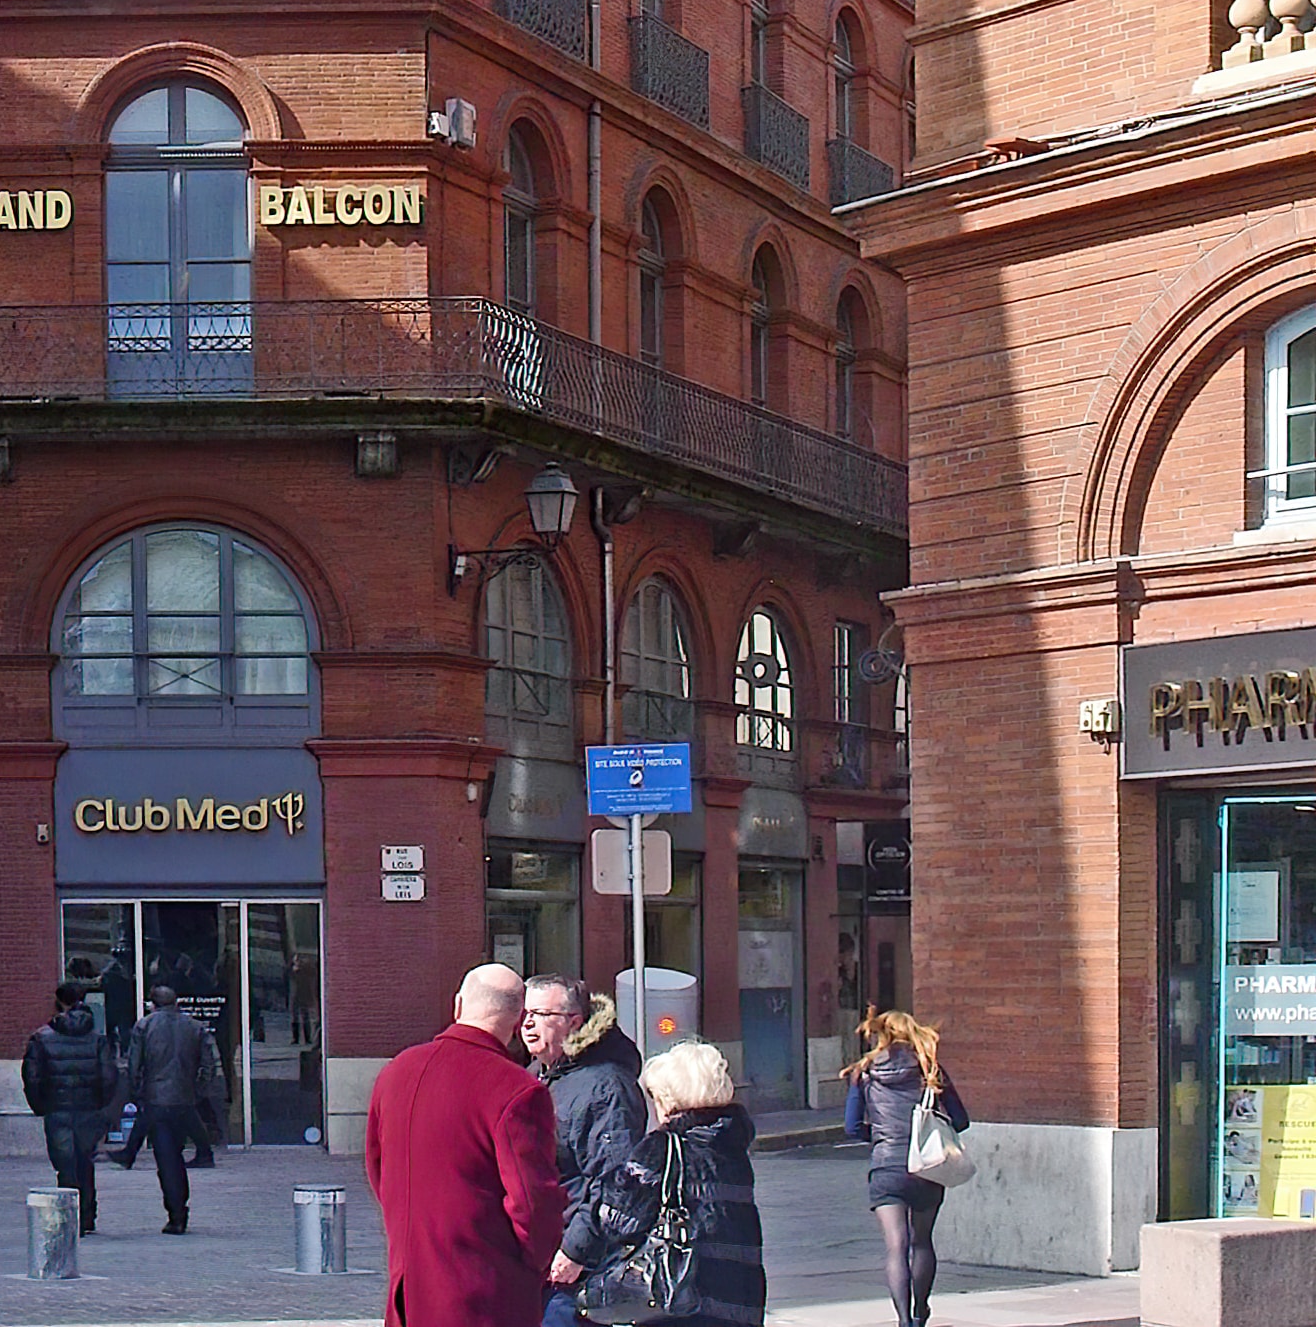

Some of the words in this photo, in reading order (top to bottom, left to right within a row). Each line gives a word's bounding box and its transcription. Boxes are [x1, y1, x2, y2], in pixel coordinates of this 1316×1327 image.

[260, 184, 421, 225] BALCON
[74, 798, 170, 832] Club
[176, 798, 269, 832] Med
